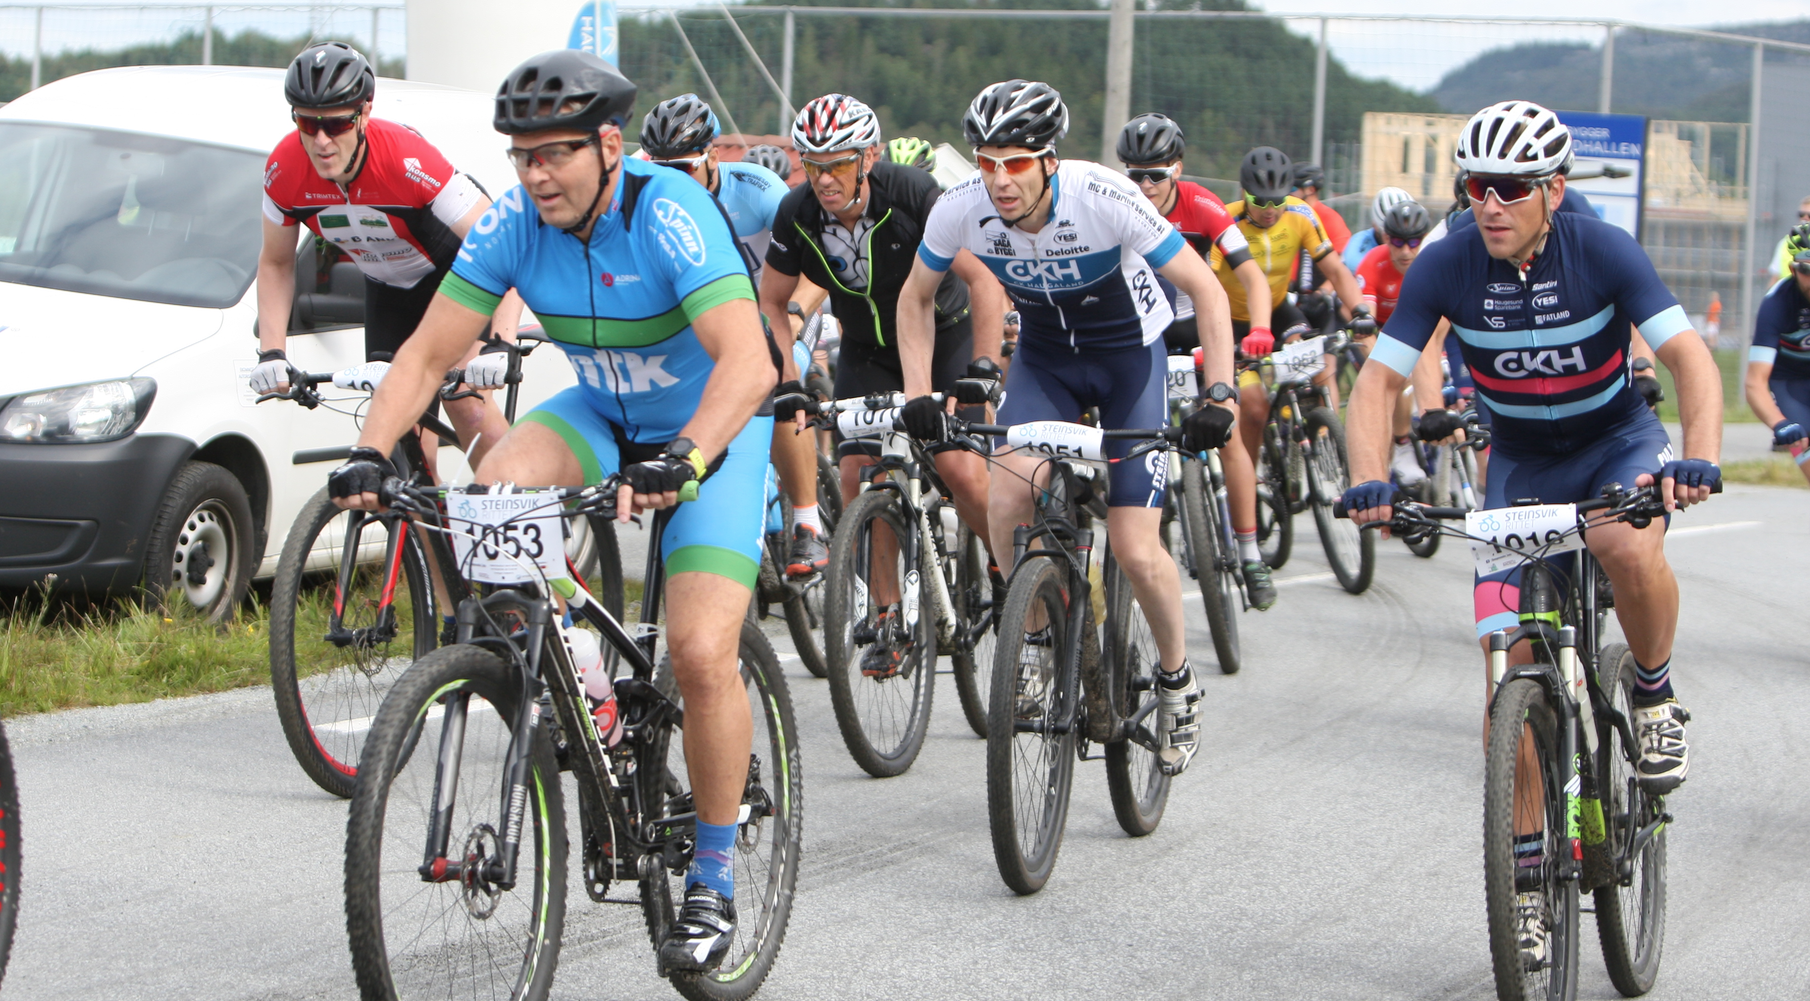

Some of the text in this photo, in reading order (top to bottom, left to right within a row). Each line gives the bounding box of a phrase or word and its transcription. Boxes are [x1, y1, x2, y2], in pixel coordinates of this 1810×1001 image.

[1046, 246, 1090, 257] Deloitte
[1543, 310, 1571, 321] FATLAND
[481, 498, 541, 511] STEINSVIK
[1505, 508, 1559, 523] STEINSVIK
[465, 522, 543, 560] 1053
[505, 784, 527, 844] ROCKSHOX
[687, 895, 718, 904] DIADORA
